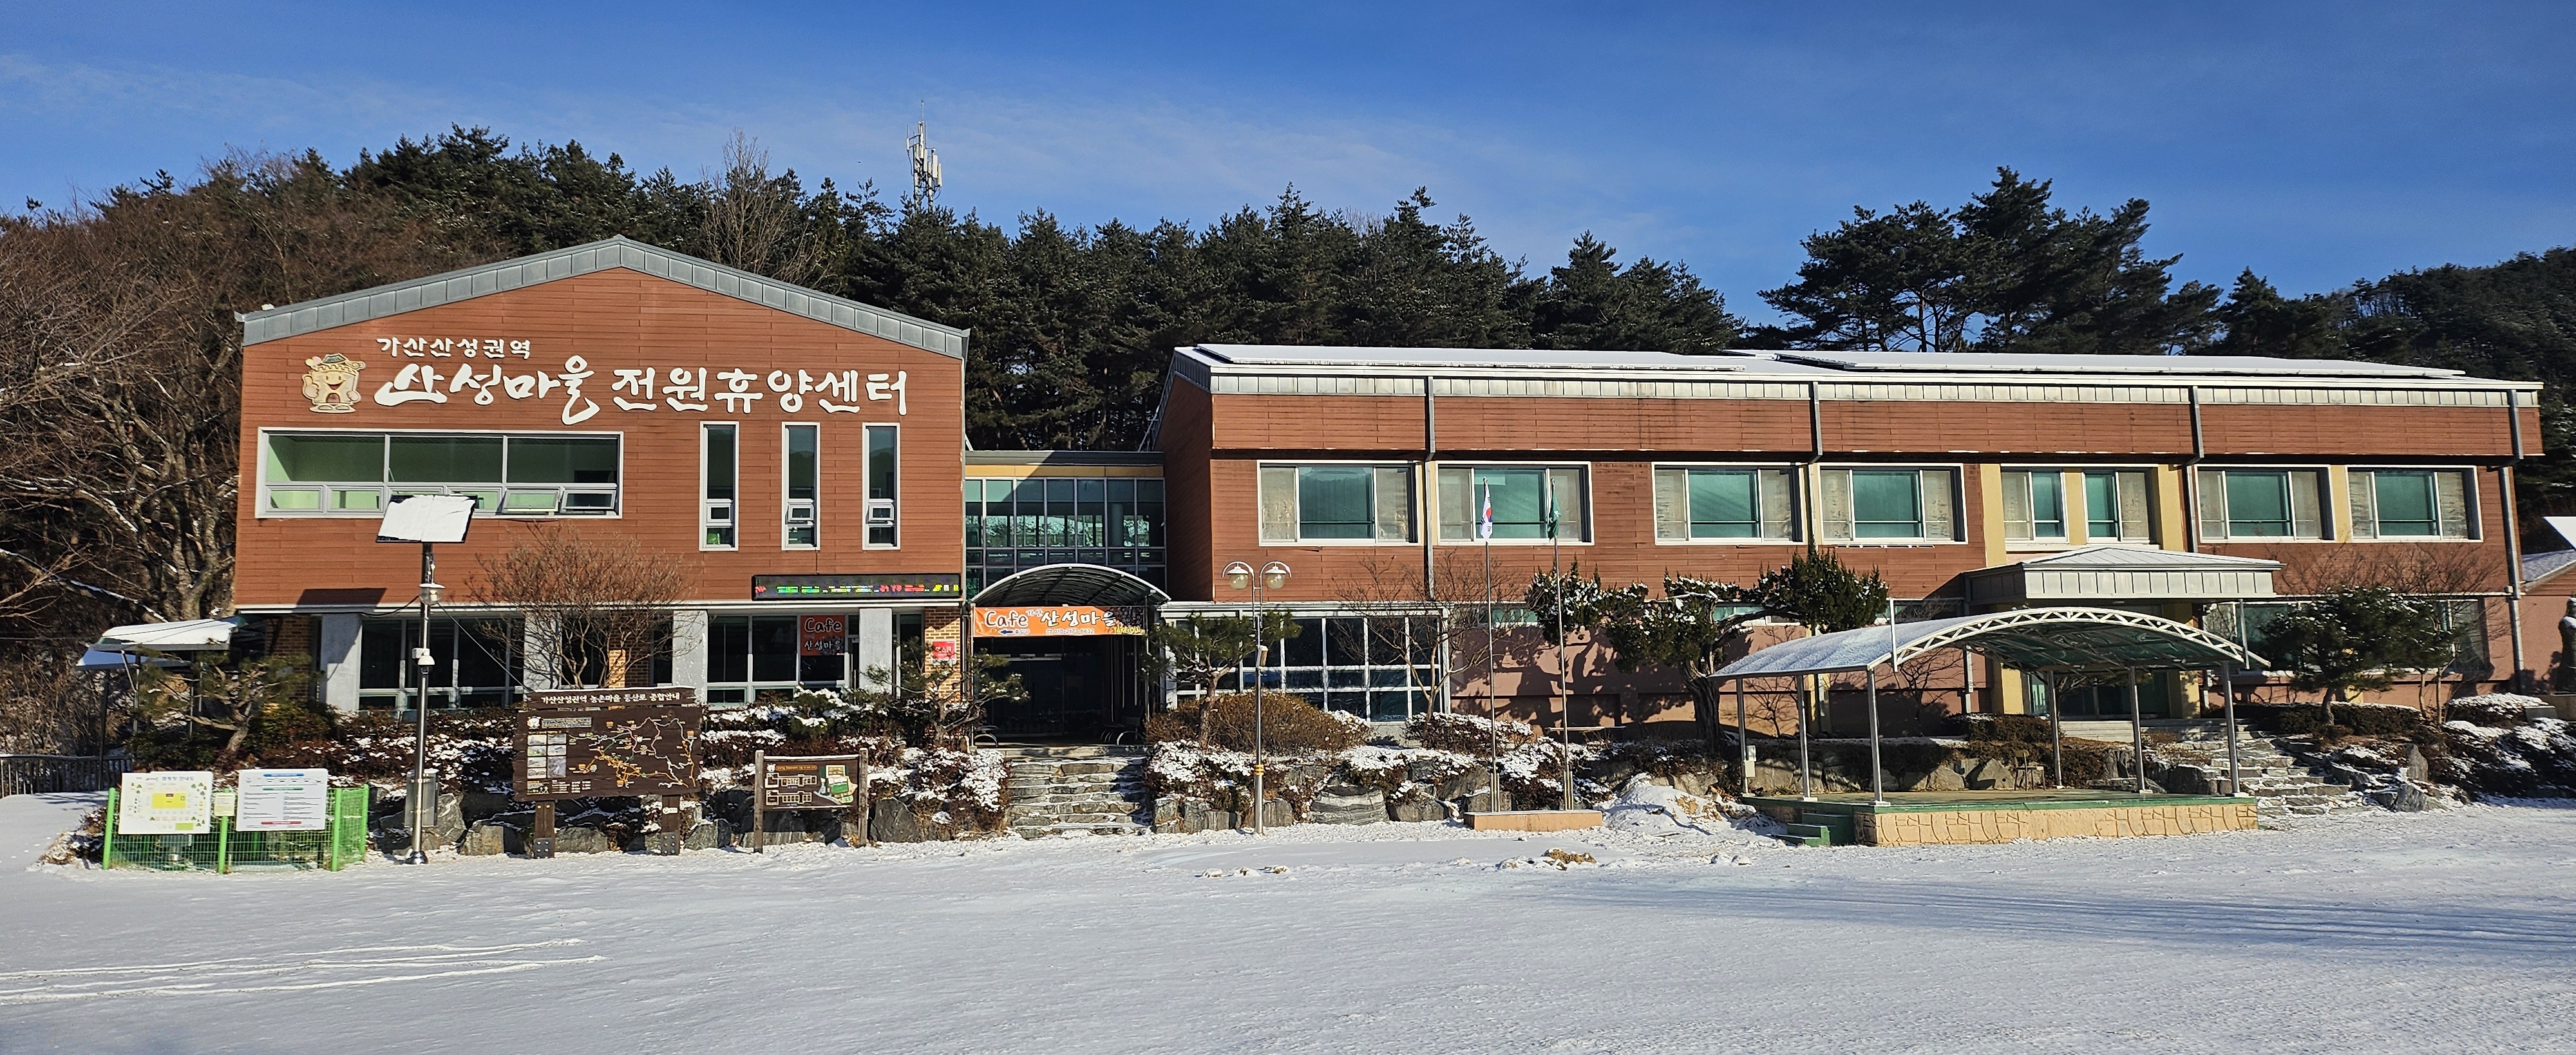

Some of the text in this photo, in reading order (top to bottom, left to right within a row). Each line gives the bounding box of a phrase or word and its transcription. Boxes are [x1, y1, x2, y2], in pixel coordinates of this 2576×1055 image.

[376, 337, 531, 359] 가산산성권역
[374, 355, 907, 425] 산성마을 전원휴양센터
[804, 618, 842, 632] Cafe
[985, 610, 1028, 628] Cafe
[1041, 610, 1117, 627] 산성마을
[804, 640, 841, 651] 산성마을
[541, 695, 587, 704] 가산산성권역
[649, 692, 680, 701] 종합안내
